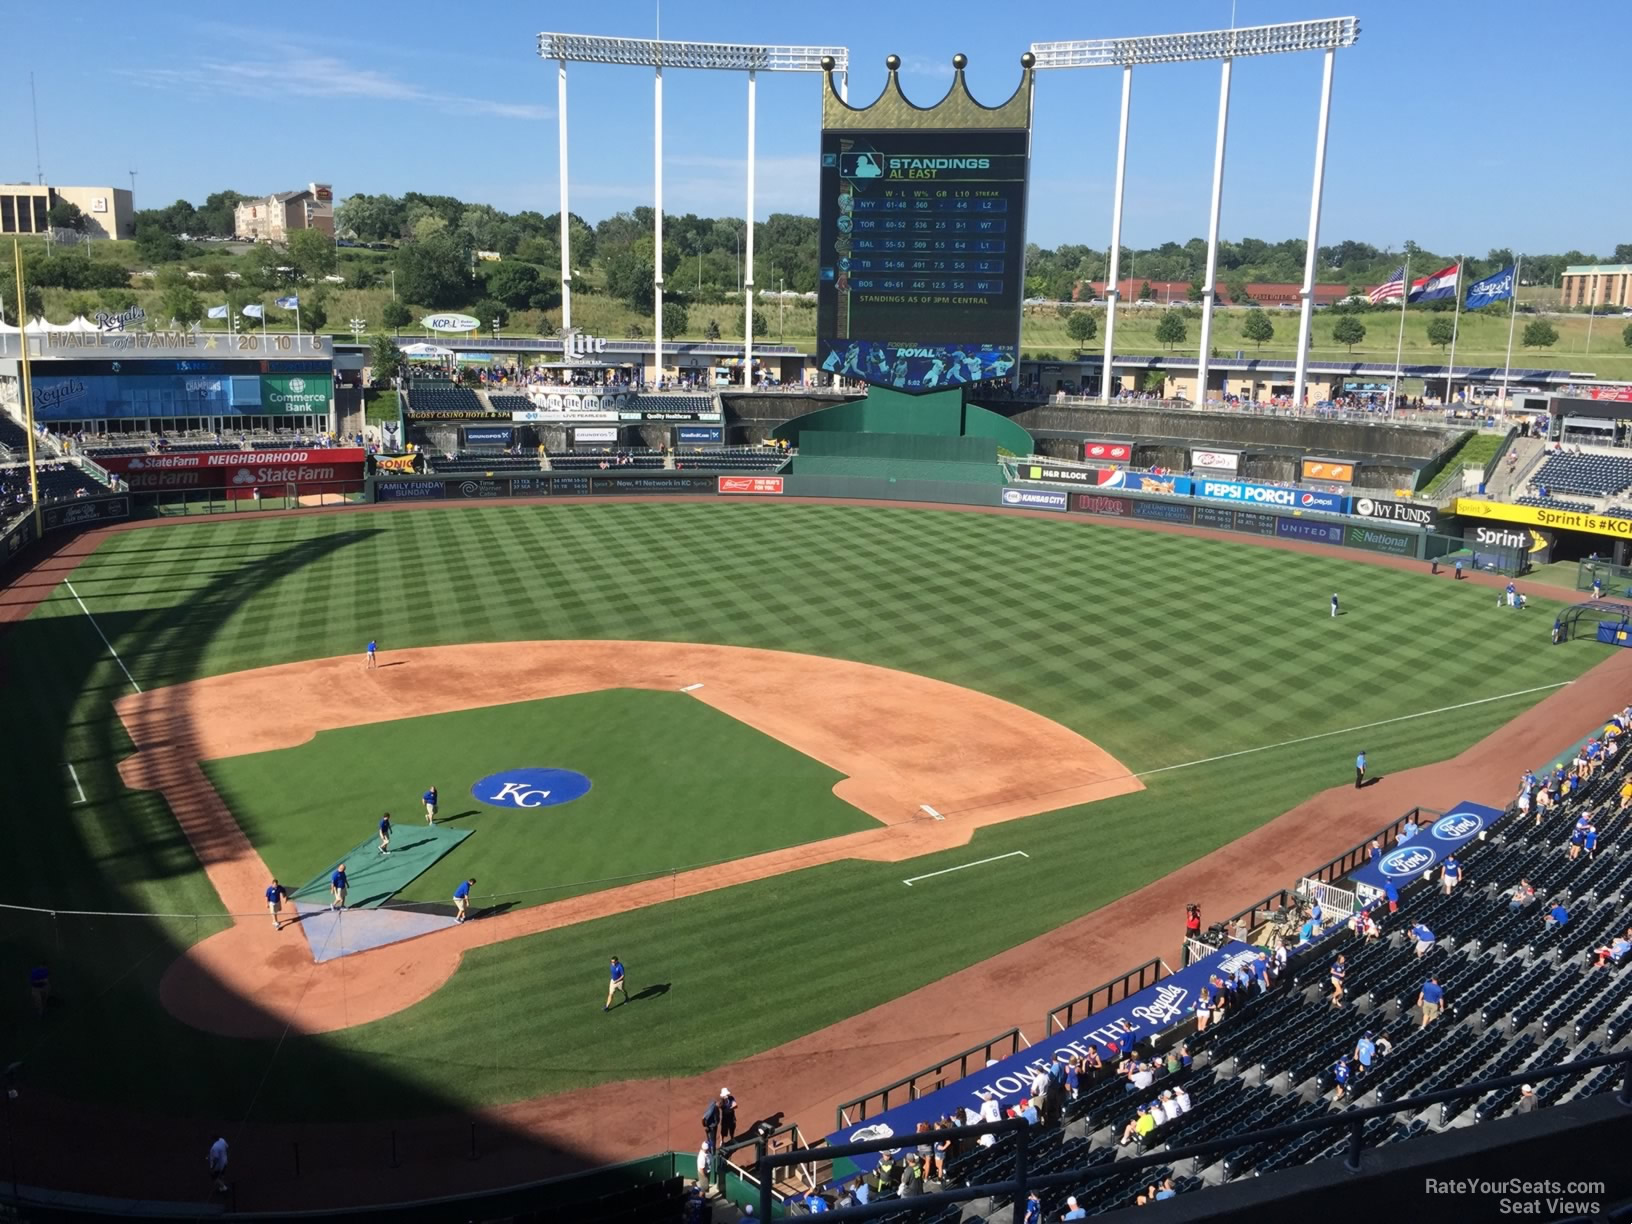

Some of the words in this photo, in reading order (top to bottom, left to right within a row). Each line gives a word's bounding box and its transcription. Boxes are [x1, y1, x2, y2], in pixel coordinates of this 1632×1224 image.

[890, 158, 990, 169] STANDINGS
[890, 169, 904, 178] AL
[908, 169, 938, 179] EAST
[96, 305, 148, 332] Royals
[432, 319, 457, 328] KCP&L
[47, 331, 108, 348] HALL
[113, 335, 132, 352] of
[134, 331, 196, 348] FAME
[238, 336, 258, 350] 20
[272, 336, 292, 350] 10
[311, 336, 322, 350] 5
[568, 333, 607, 359] Lite
[896, 348, 936, 358] ROYAL
[186, 380, 221, 391] CHAMPIONS
[32, 379, 87, 408] Royals
[270, 393, 326, 402] Commerce
[285, 403, 312, 412] Bank
[584, 399, 598, 408] Lite
[208, 452, 308, 465] NEIGHBORHOOD
[378, 460, 413, 468] SONIC
[1043, 469, 1060, 478] H&R
[1061, 470, 1087, 480] BLOCK
[378, 482, 409, 490] FAMILY
[396, 489, 430, 497] SUNDAY
[1022, 494, 1049, 503] KANSAS
[1049, 495, 1064, 504] CITY
[1204, 482, 1241, 498] PEPSI
[1244, 487, 1295, 505] PORCH
[1314, 498, 1332, 506] pepsi
[1142, 508, 1164, 516] KANSAS
[1165, 511, 1190, 520] HOSPITAL
[1152, 504, 1186, 513] UNIVERSITY
[1374, 501, 1392, 518] IVY
[1394, 503, 1432, 524] FUNDS
[1458, 503, 1481, 514] Sprint
[1537, 510, 1580, 526] Sprint
[1584, 516, 1596, 528] is
[1281, 524, 1327, 536] UNITED
[1364, 531, 1408, 547] National
[1476, 527, 1526, 548] Sprint
[490, 782, 551, 808] KC
[1439, 817, 1477, 837] Ford
[1388, 851, 1429, 872] Ford
[1132, 984, 1188, 1024] Royals
[971, 1058, 1052, 1101] HOME
[1057, 1040, 1094, 1064] OF
[1083, 1017, 1140, 1046] THE
[992, 1108, 998, 1117] 8
